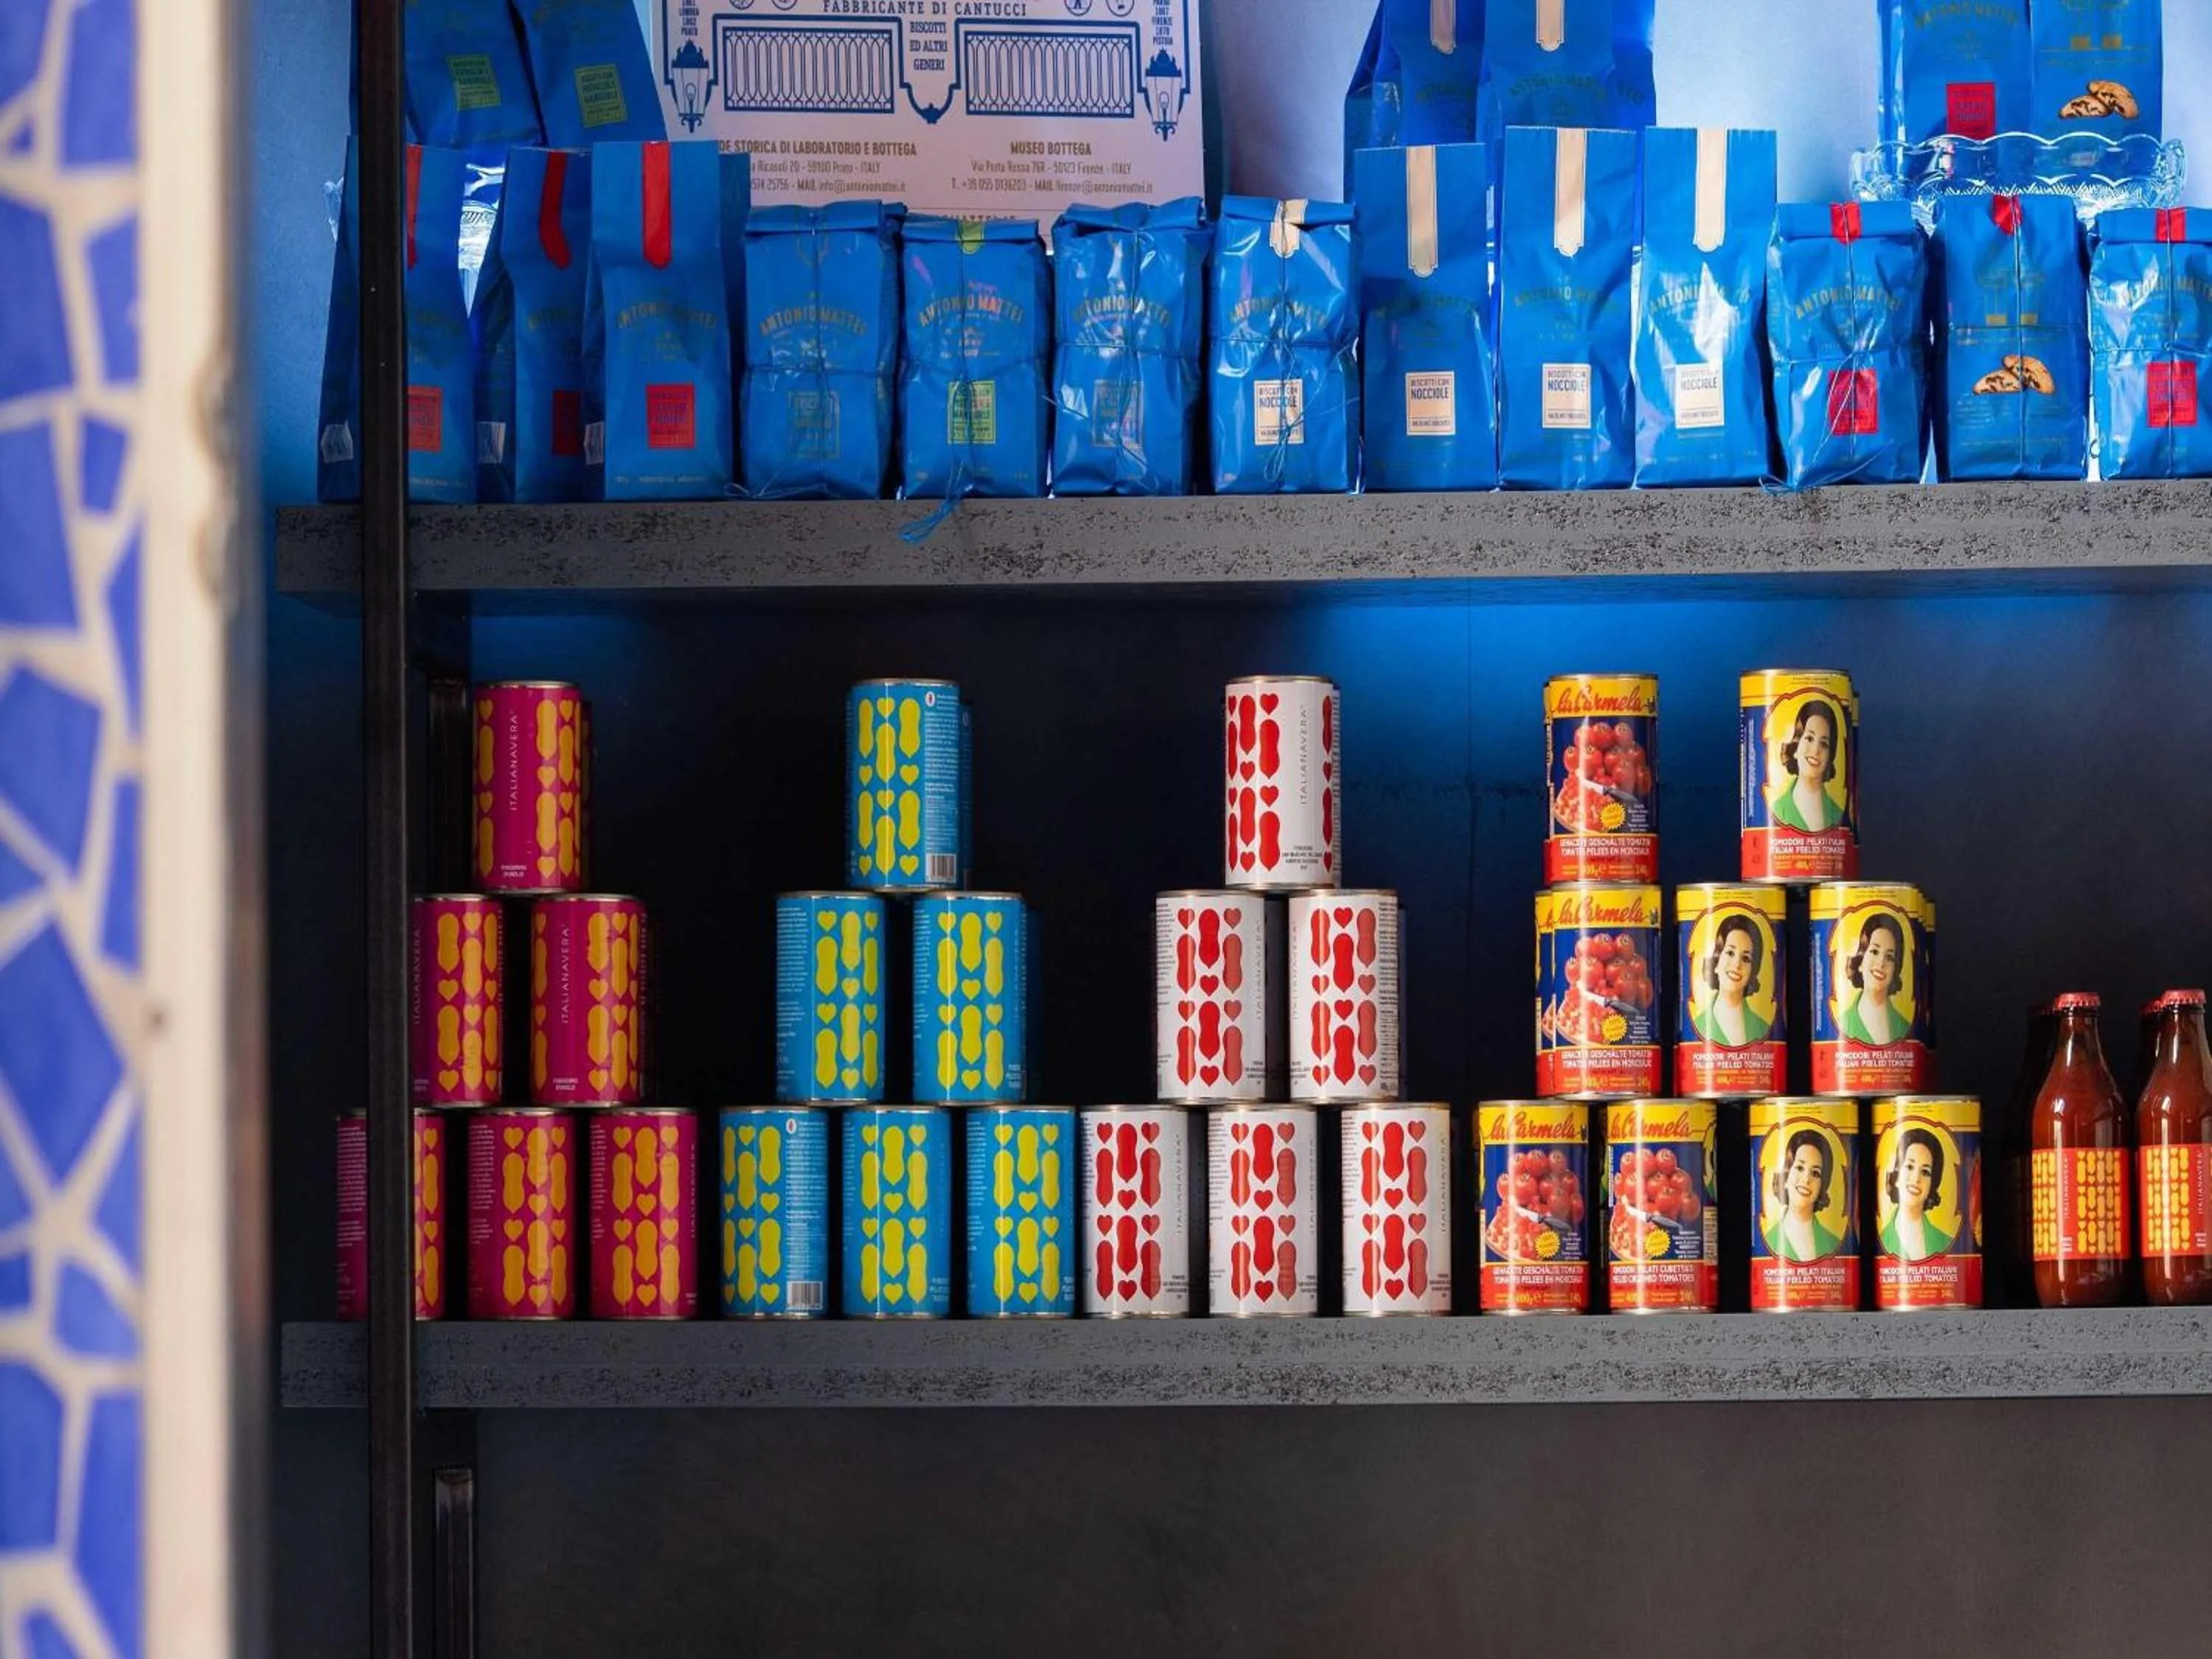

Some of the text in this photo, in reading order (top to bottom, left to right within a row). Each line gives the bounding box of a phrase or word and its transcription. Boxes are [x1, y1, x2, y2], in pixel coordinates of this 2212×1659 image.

[824, 0, 1027, 16] FABBRICANTE DI CANTUCCI
[909, 21, 947, 34] BISCOTTI
[910, 40, 948, 52] ED ALTRI
[914, 58, 945, 70] GENERI
[734, 140, 779, 153] STORICA
[779, 141, 791, 154] DI
[793, 141, 860, 155] LABORATORIO
[863, 142, 870, 155] E
[872, 142, 917, 156] BOTTEGA
[1010, 141, 1092, 156] MUSEO BOTTEGA
[1411, 387, 1449, 400] NOCCIOLE
[509, 714, 518, 811] ITALIANAVERA
[1300, 709, 1308, 805] ITALIANAVERA
[561, 928, 569, 1024] ITALIANAVERA
[1660, 1274, 1694, 1283] TOMATOES
